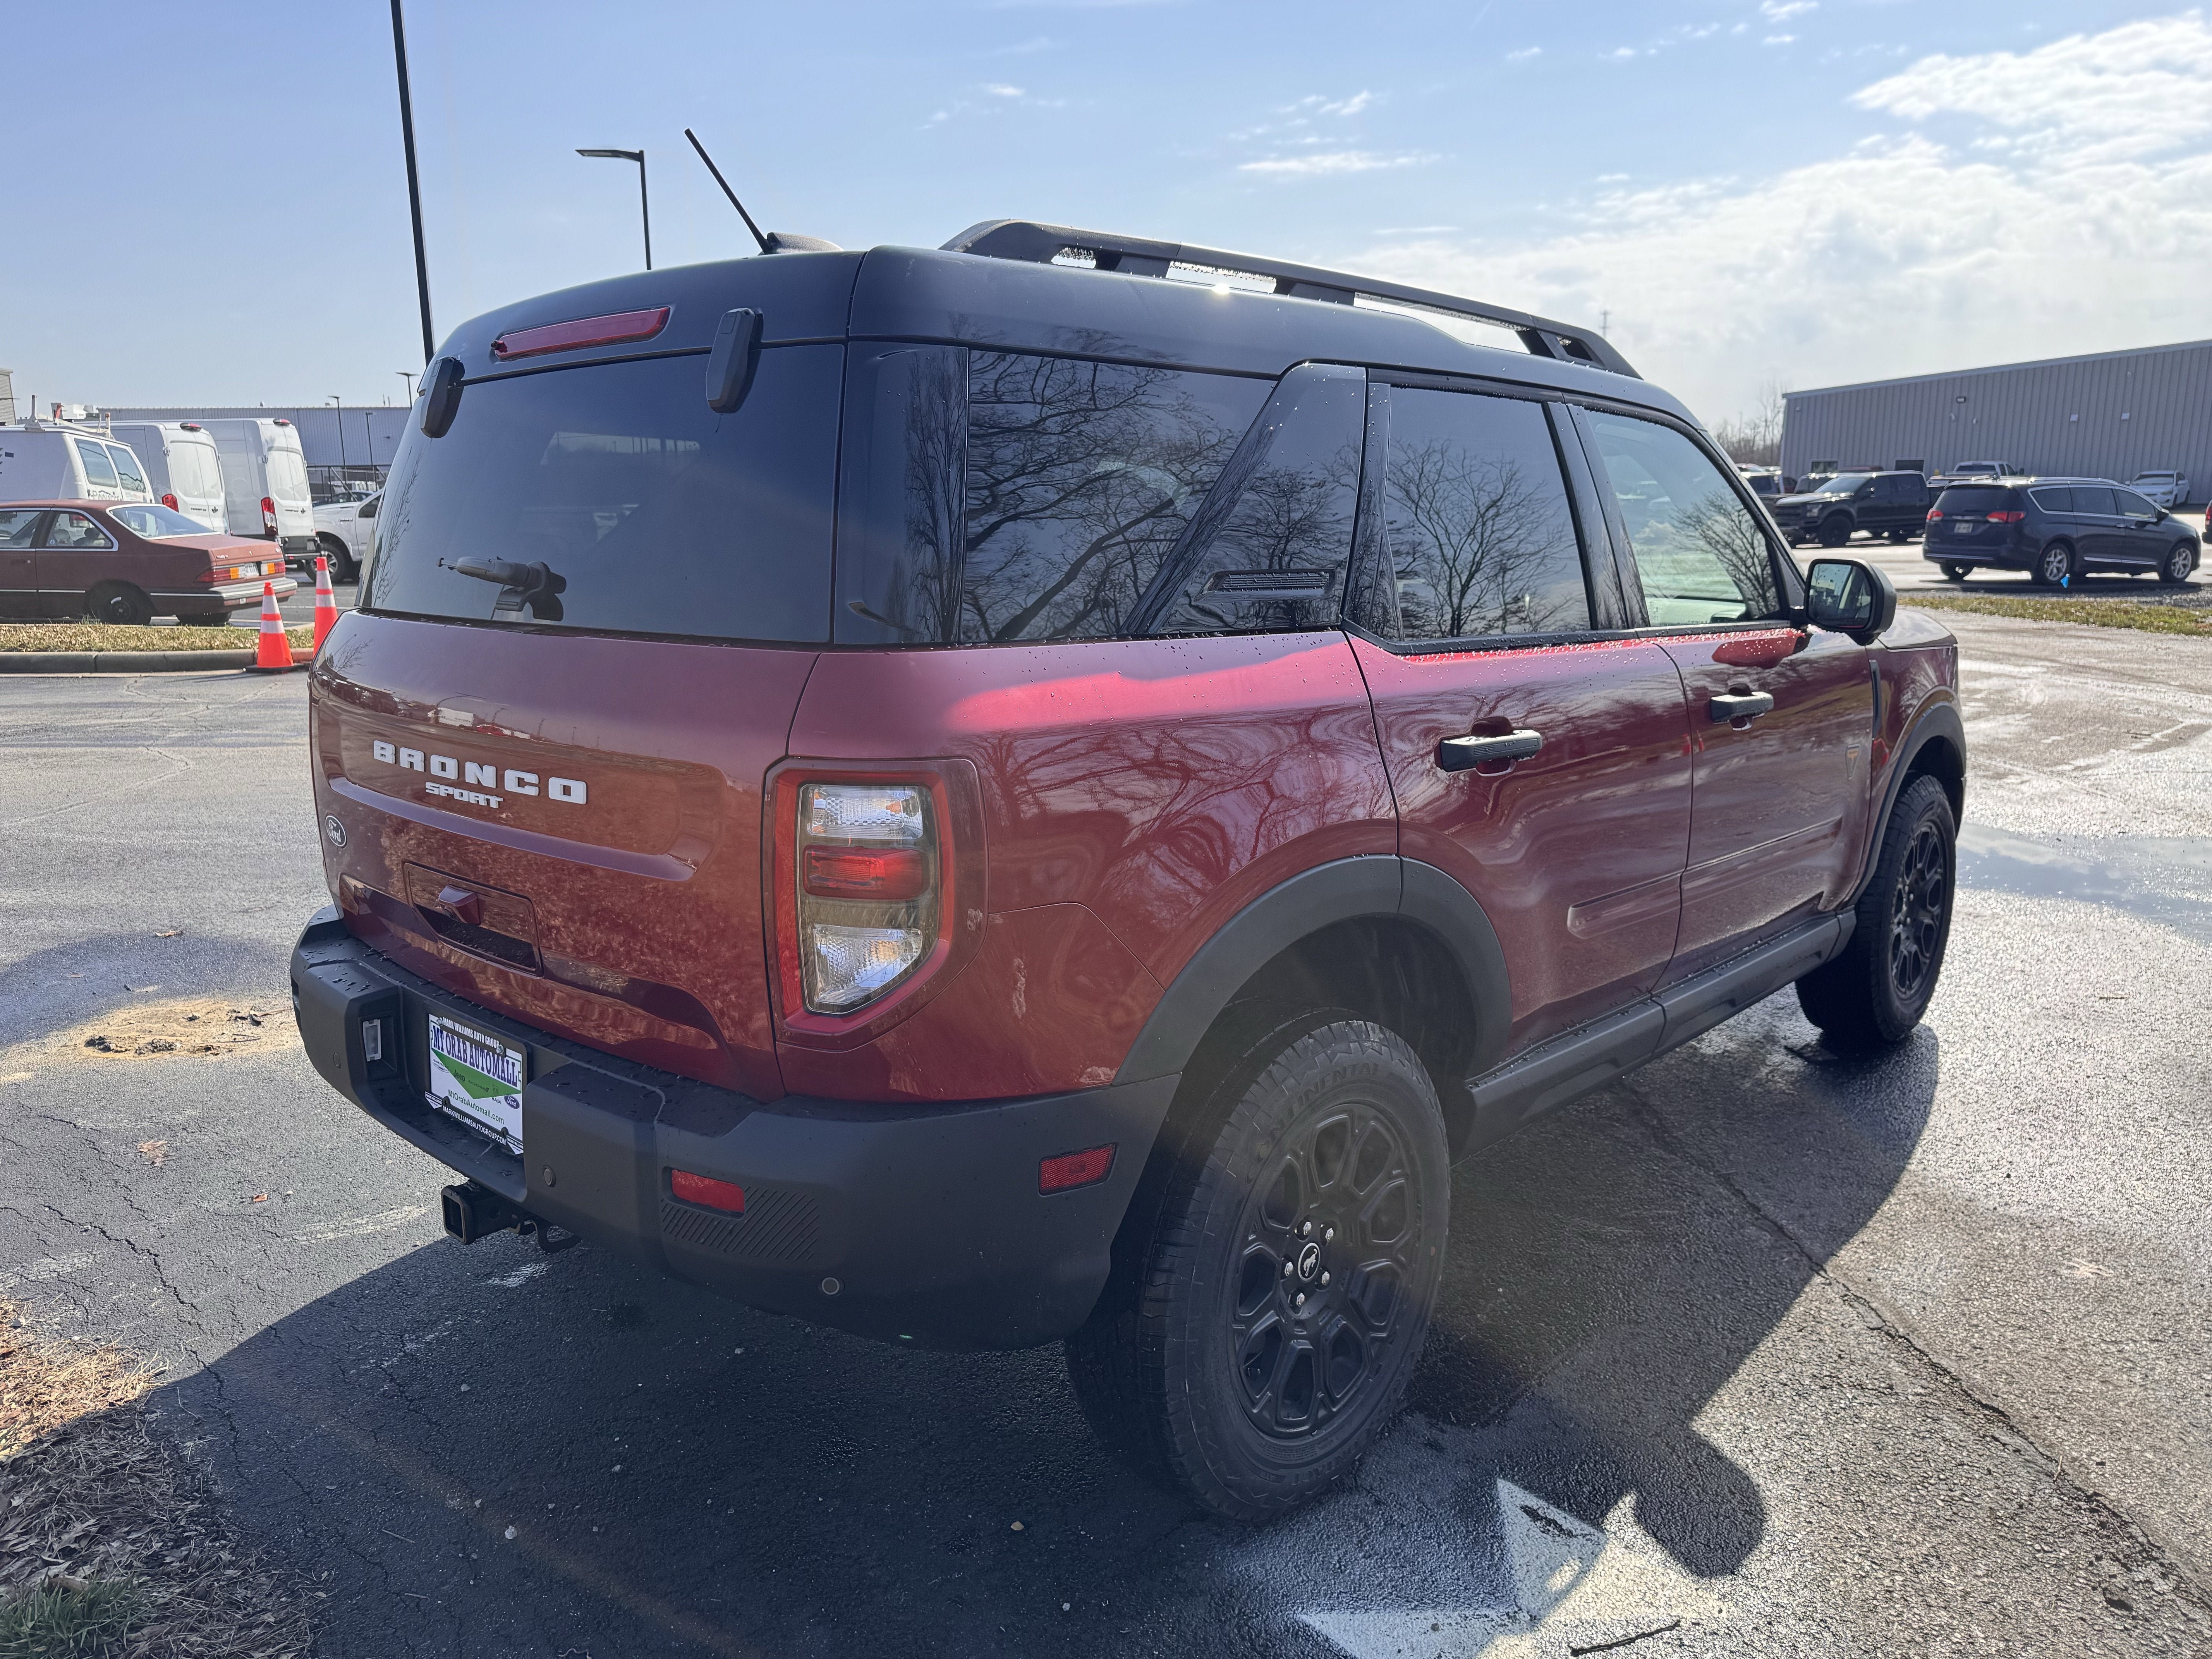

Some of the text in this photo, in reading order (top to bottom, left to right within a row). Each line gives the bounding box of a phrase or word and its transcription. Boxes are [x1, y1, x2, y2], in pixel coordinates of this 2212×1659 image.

[373, 740, 587, 805] BRONCO
[426, 781, 503, 808] SPORT
[443, 1017, 500, 1048] MARK WILLIAMS AUTO GROUP
[433, 1025, 517, 1087] MT ORAB AUTOMALL
[443, 1105, 506, 1146] MARKWILLIAMSAUTOGROUP.COM
[448, 1089, 504, 1124] MtOrabAutomall.com
[1244, 1062, 1379, 1186] CONTINENTAL
